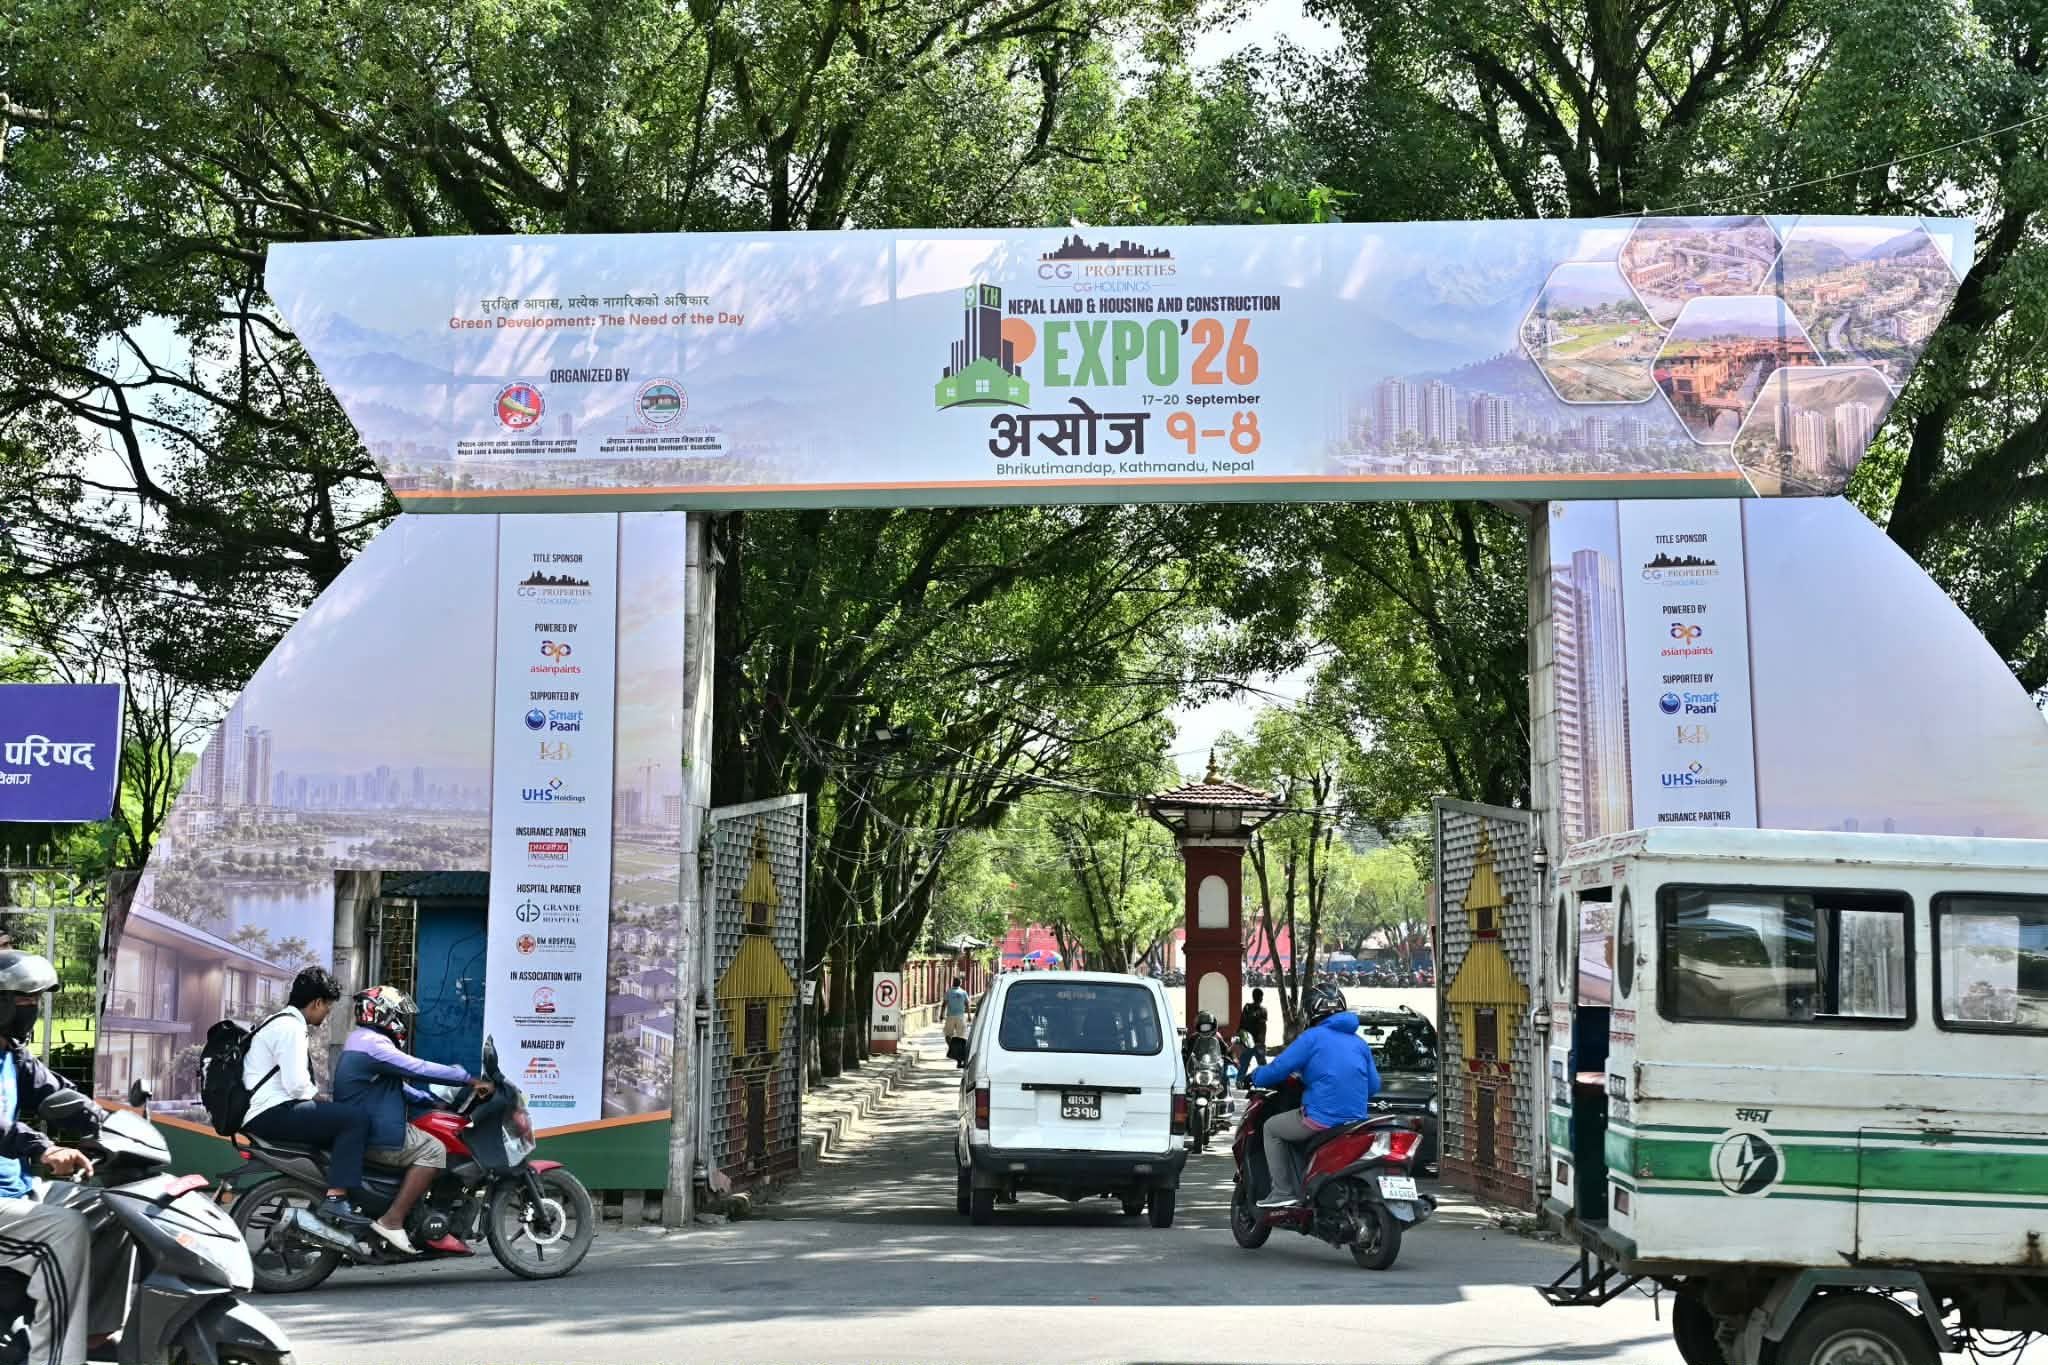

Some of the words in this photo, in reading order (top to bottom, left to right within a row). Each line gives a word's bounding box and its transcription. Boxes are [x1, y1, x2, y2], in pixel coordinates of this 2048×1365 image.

[1038, 264, 1073, 280] CG
[1085, 264, 1176, 277] PROPERTIES
[1094, 281, 1152, 292] HOLDINGS
[480, 298, 519, 313] सुरक्षित
[568, 295, 599, 309] प्रत्येक
[602, 294, 658, 308] नागरिकको
[663, 293, 709, 307] अधिकार
[1008, 298, 1048, 315] NEPAL
[1050, 297, 1084, 314] LAND
[1087, 298, 1096, 313] &
[1099, 297, 1153, 314] HOUSING
[1157, 296, 1183, 312] AND
[1186, 295, 1280, 312] CONSTRUCTION
[450, 316, 492, 329] Green
[497, 315, 595, 330] Development:
[600, 314, 626, 327] The
[629, 313, 667, 326] Need
[671, 313, 687, 326] of
[689, 312, 714, 325] the
[718, 312, 744, 327] Day
[550, 368, 612, 383] ORGANIZED
[614, 367, 630, 382] BY
[1185, 393, 1260, 409] September
[988, 397, 1150, 458] असोज
[996, 463, 1115, 476] Bhrikutimandap,
[1119, 461, 1208, 475] Kathmandu,
[1213, 460, 1254, 475] Nepal
[1656, 535, 1674, 544] TITLE
[1675, 534, 1708, 544] SPONSOR
[533, 553, 550, 563] TITLE
[552, 554, 583, 563] SPONSOR
[1662, 604, 1696, 614] POWERED
[1698, 604, 1707, 614] BY
[535, 623, 567, 632] POWERED
[568, 623, 577, 632] BY
[1663, 674, 1703, 684] SUPPORTED
[1704, 673, 1714, 683] BY
[530, 691, 568, 701] SUPPORTED
[570, 691, 580, 701] BY
[1684, 691, 1720, 703] Smart
[1685, 703, 1717, 714] Paani
[548, 709, 584, 721] Smart
[549, 720, 580, 732] Paani
[4, 734, 96, 771] परिषद
[1661, 773, 1694, 786] UHS
[1695, 777, 1727, 787] Holdings
[522, 788, 553, 801] UHS
[554, 794, 586, 804] Holdings
[1658, 812, 1697, 823] INSURANCE
[1698, 811, 1731, 822] PARTNER
[516, 827, 554, 837] INSURANCE
[555, 828, 586, 837] PARTNER
[517, 884, 547, 893] HOSPITAL
[550, 885, 581, 894] PARTNER
[510, 971, 518, 980] IN
[519, 971, 562, 981] ASSOCIATION
[564, 972, 582, 981] WITH
[873, 1025, 897, 1033] PARKING
[521, 1040, 555, 1049] MANAGED
[556, 1040, 565, 1049] BY
[1736, 1108, 1773, 1123] सफा
